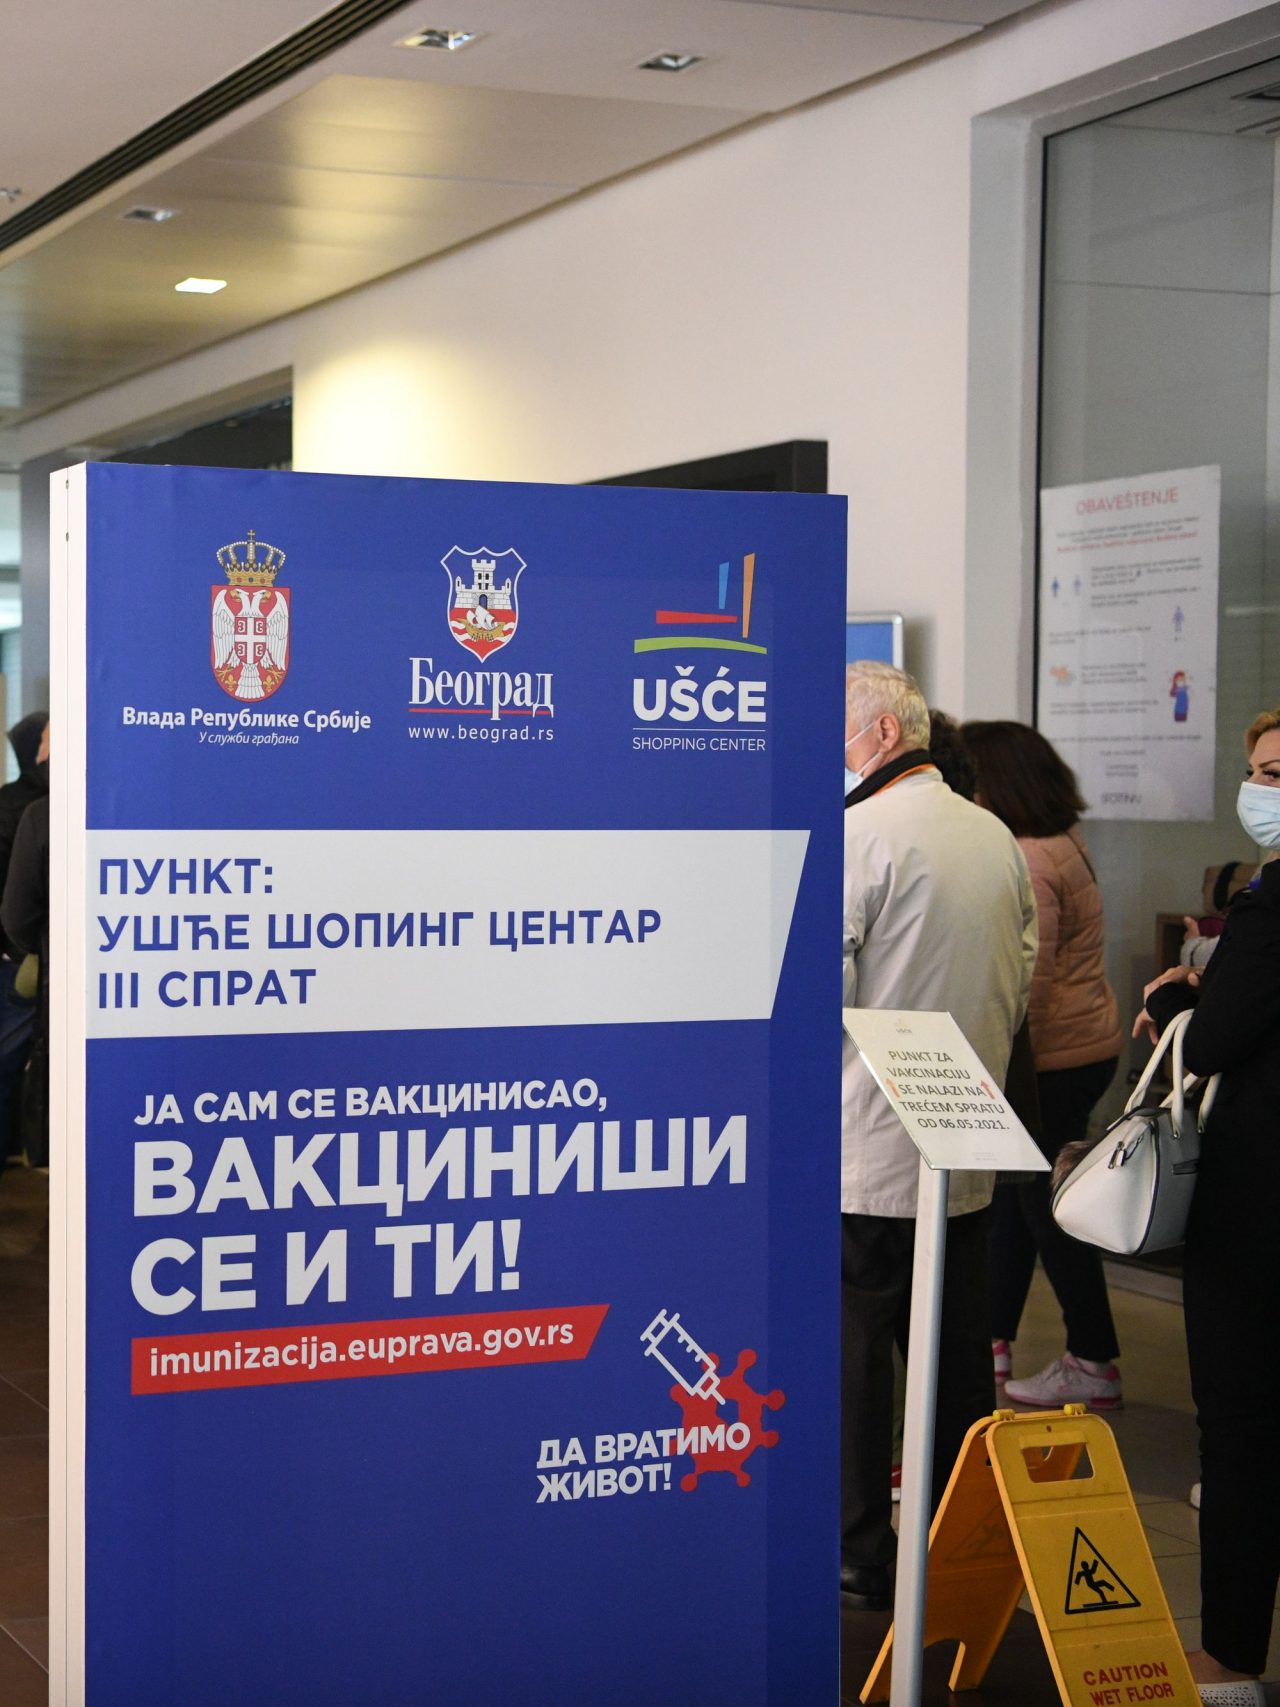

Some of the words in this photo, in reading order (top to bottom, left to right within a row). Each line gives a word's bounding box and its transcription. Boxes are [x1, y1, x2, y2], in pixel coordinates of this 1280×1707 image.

[1076, 486, 1179, 516] OBAVEŠTENJE
[409, 656, 554, 720] Београд
[633, 666, 767, 723] UŠĆE
[122, 706, 186, 730] Влада
[190, 708, 300, 732] Републике
[303, 710, 372, 733] Србије
[408, 724, 554, 744] www.beograd.rs
[199, 732, 208, 743] У
[208, 732, 250, 746] служби
[251, 732, 300, 746] грађана
[632, 737, 707, 751] SHOPPING
[709, 737, 766, 751] CENTER
[98, 858, 274, 895] ПУНКТ:
[97, 914, 250, 953] УШЋЕ
[267, 911, 474, 950] ШОПИНГ
[489, 909, 661, 952] ЦЕНТАР
[158, 969, 317, 1008] СПРАТ
[888, 1050, 933, 1063] PUNKT
[935, 1052, 954, 1063] ZA
[887, 1067, 971, 1080] VAKCINACIJU
[134, 1094, 184, 1126] ЈА
[193, 1090, 277, 1123] САМ
[288, 1088, 335, 1119] СЕ
[346, 1077, 607, 1118] ВАКЦИНИСАО,
[898, 1084, 916, 1095] SE
[917, 1084, 964, 1096] NALAZI
[966, 1086, 987, 1097] NA
[899, 1099, 954, 1113] TREĆEM
[955, 1103, 1005, 1114] SPRATU
[917, 1118, 938, 1129] OD
[939, 1119, 1010, 1130] 06.05.2021.
[133, 1115, 747, 1217] ВАКЦИНИШИ
[130, 1234, 257, 1316] СЕ
[286, 1229, 347, 1305] И
[375, 1219, 522, 1298] ТИ!
[149, 1321, 575, 1378] imunizacija.euprava.gov.rs
[536, 1437, 588, 1469] ДА
[595, 1422, 751, 1463] ВРАТИМО
[536, 1463, 672, 1503] ЖИВОТ!
[1083, 1662, 1169, 1685] CAUTION
[1090, 1688, 1121, 1706] WET
[1127, 1683, 1175, 1701] FLOOR
